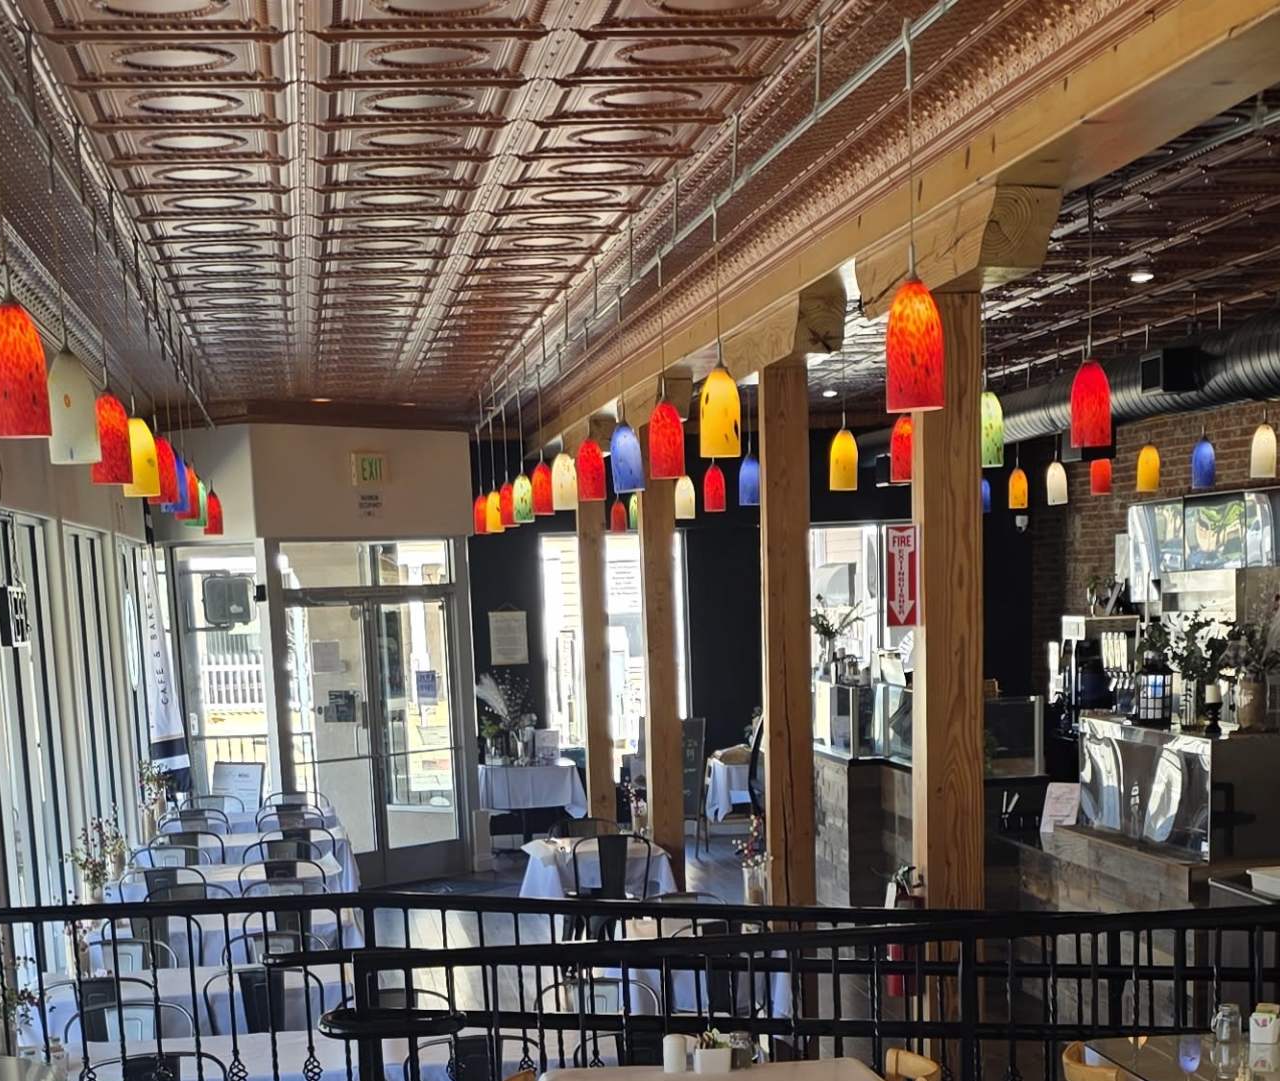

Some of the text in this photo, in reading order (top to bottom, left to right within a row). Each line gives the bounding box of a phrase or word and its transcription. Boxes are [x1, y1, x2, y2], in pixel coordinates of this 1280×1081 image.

[361, 457, 384, 481] EXIT
[892, 536, 912, 547] FIRE
[153, 650, 161, 658] &
[155, 667, 169, 705] CAFE
